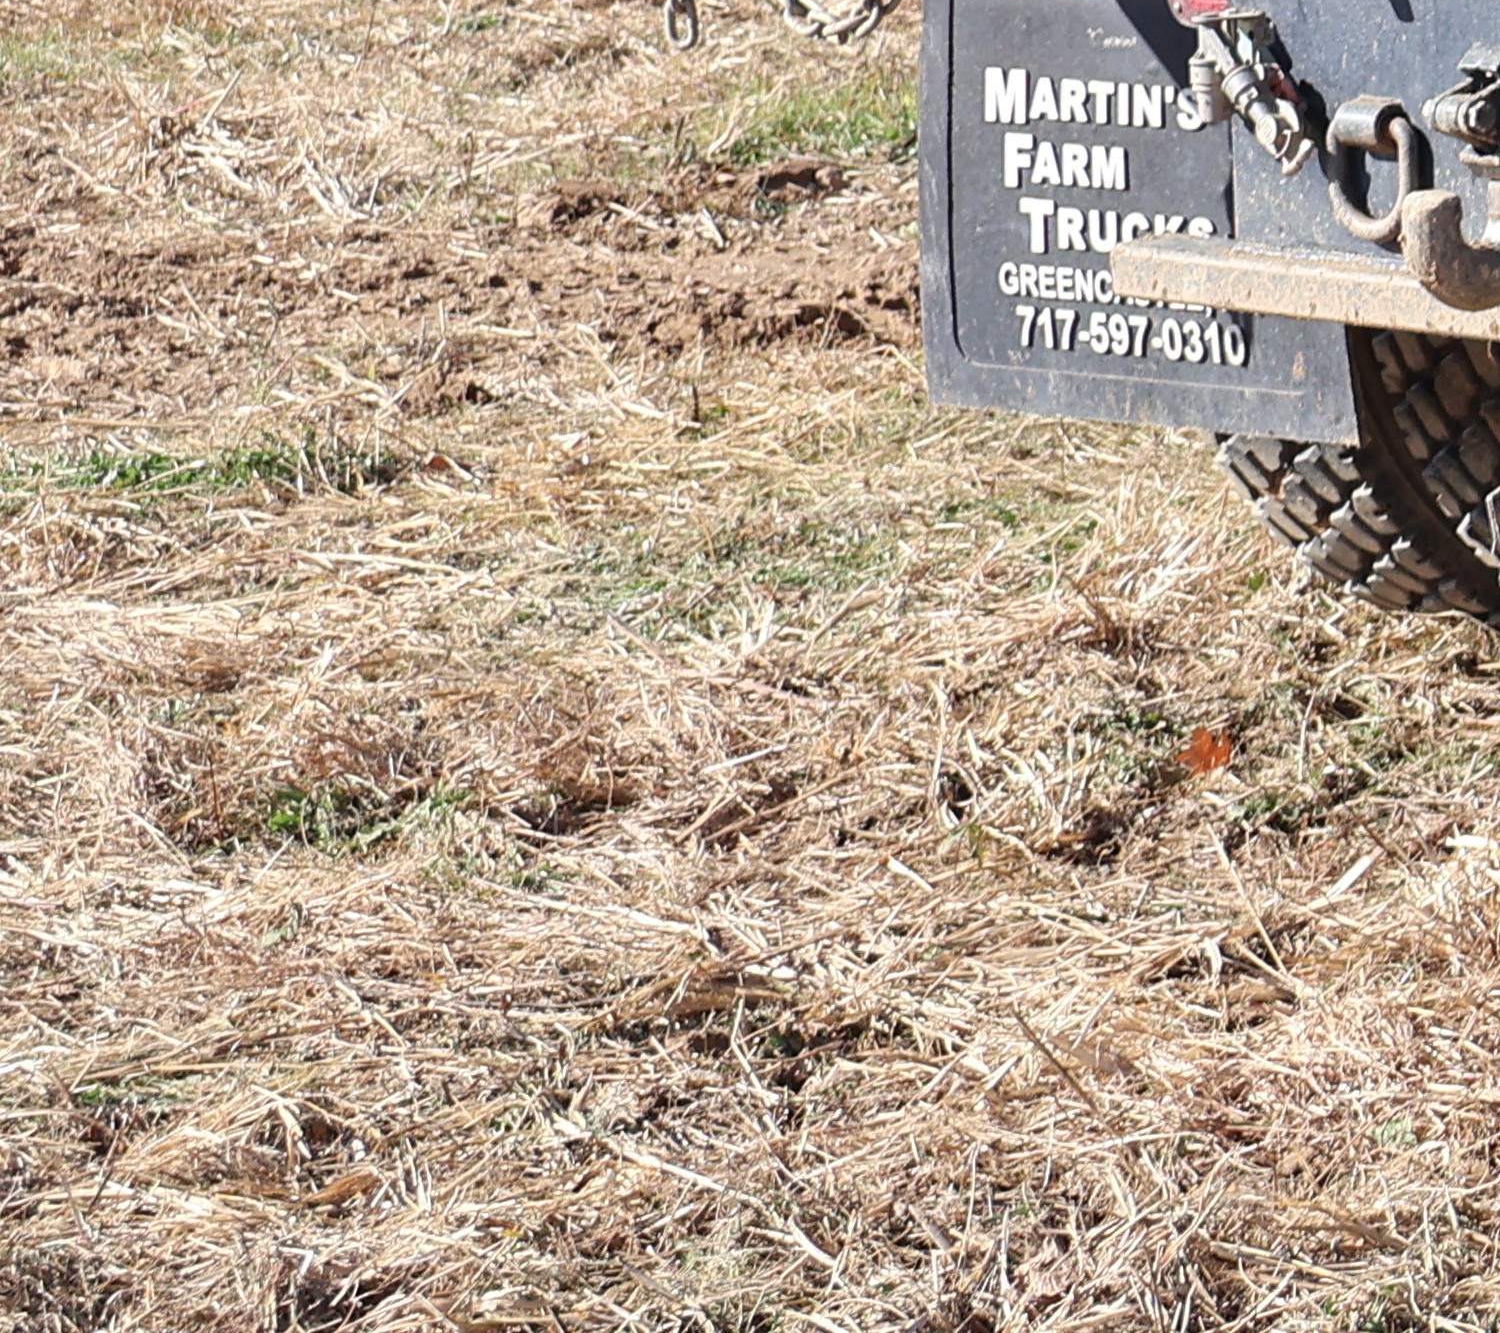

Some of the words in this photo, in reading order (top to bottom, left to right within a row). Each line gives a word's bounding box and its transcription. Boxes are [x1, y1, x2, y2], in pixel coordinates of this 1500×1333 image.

[984, 67, 1203, 130] MARTIN'S
[1003, 132, 1126, 190] FARM
[1015, 304, 1246, 367] 717-597-0310
